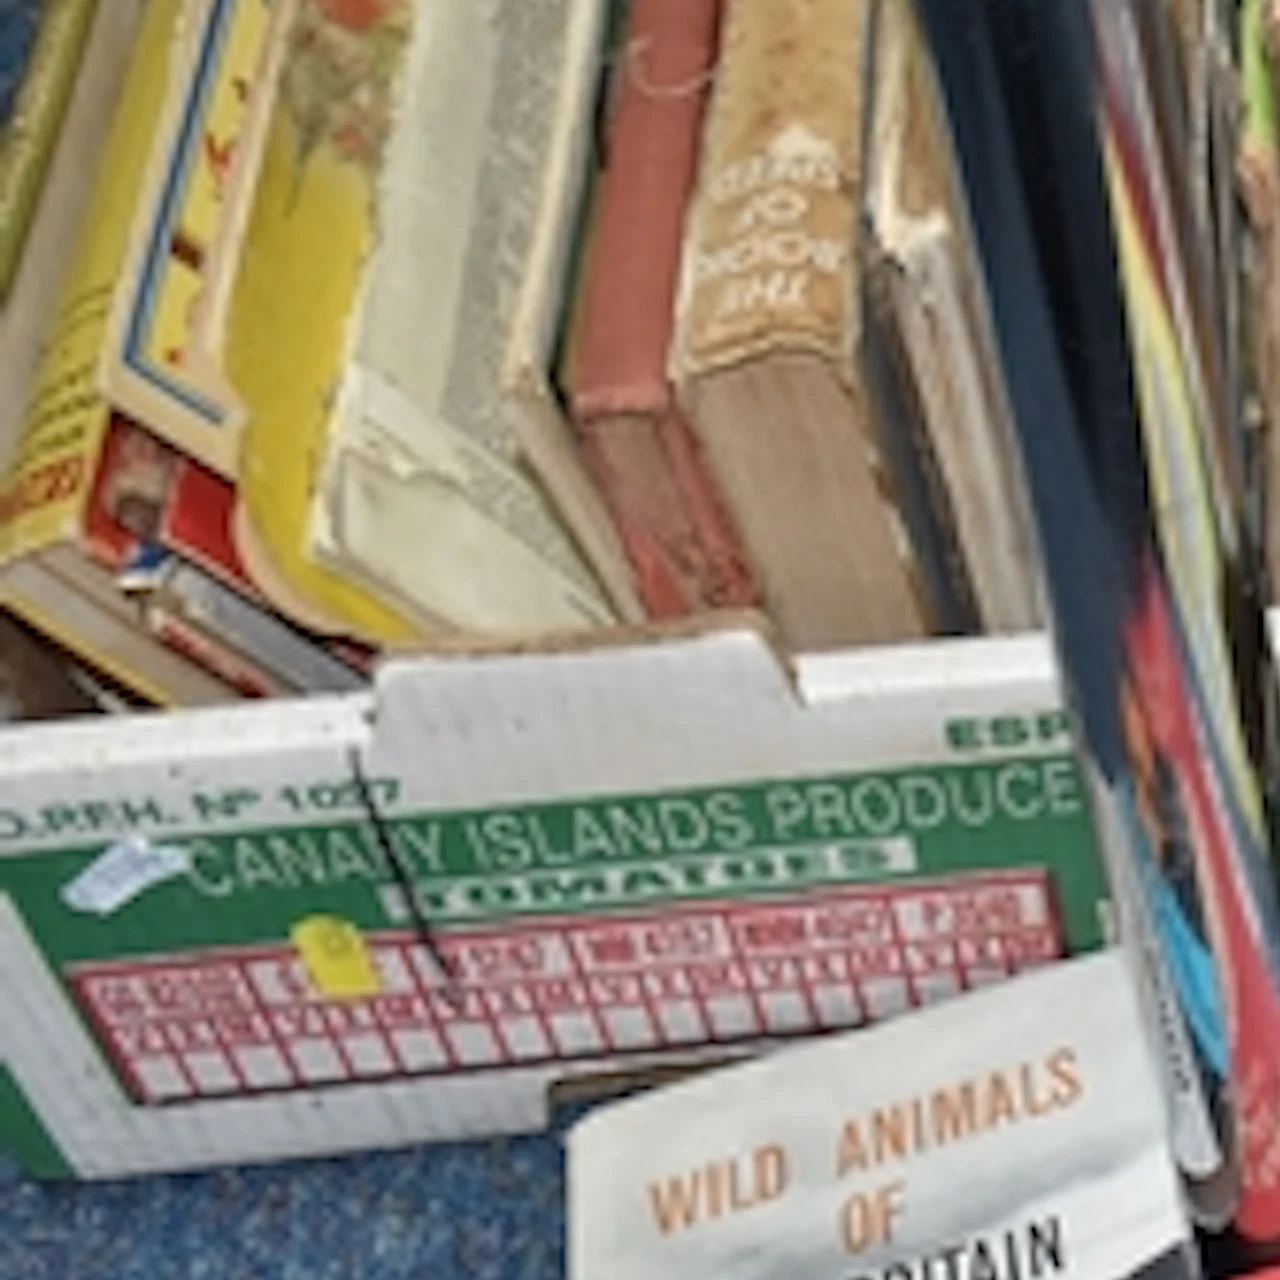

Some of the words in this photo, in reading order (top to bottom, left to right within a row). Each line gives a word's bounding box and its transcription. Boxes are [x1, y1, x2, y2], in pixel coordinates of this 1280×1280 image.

[466, 790, 755, 871] ISLANDS
[765, 760, 1082, 841] PRODUCE
[415, 846, 891, 913] TOMATOES
[647, 1142, 788, 1236] WILD
[835, 1046, 1084, 1179] ANIMALS
[840, 1179, 907, 1255] OF
